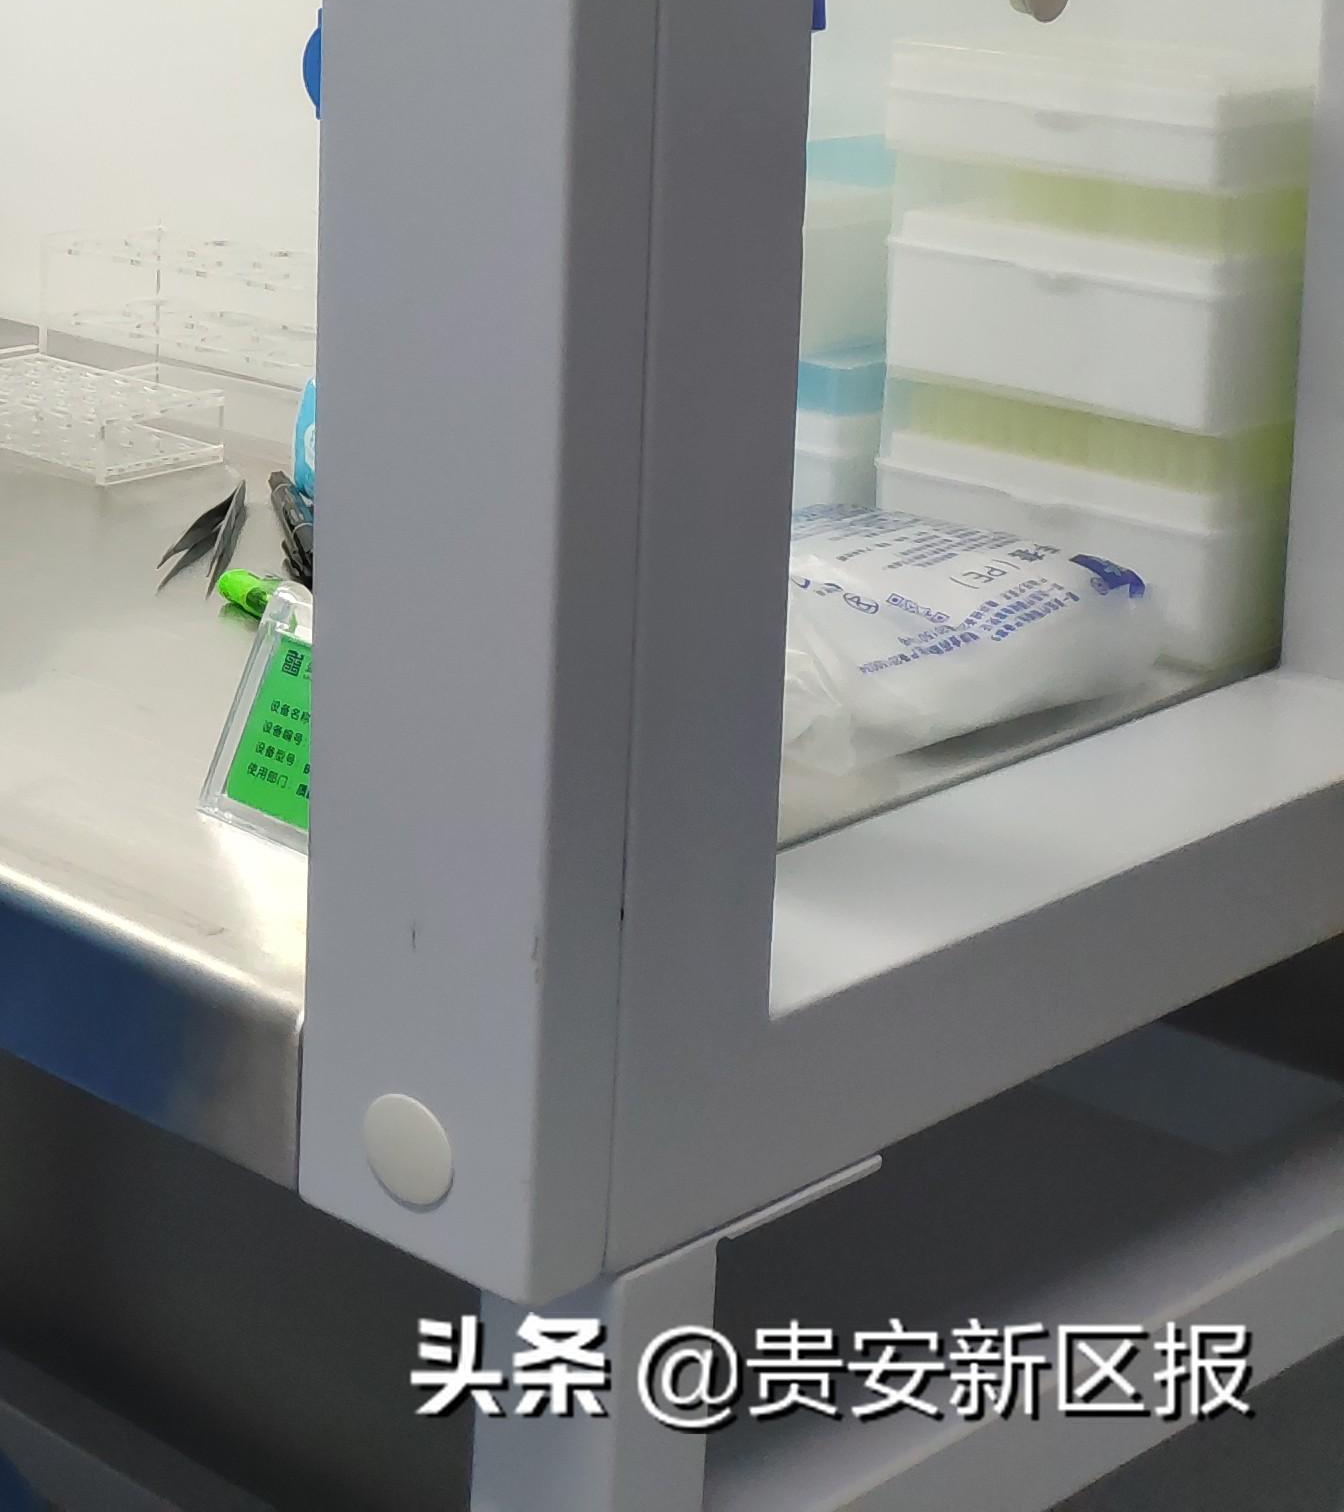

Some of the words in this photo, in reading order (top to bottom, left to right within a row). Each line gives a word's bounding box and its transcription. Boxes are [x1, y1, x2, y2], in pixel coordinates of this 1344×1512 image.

[262, 720, 303, 746] 设备编号
[255, 741, 296, 767] 设备型号
[247, 761, 289, 789] 使用部门
